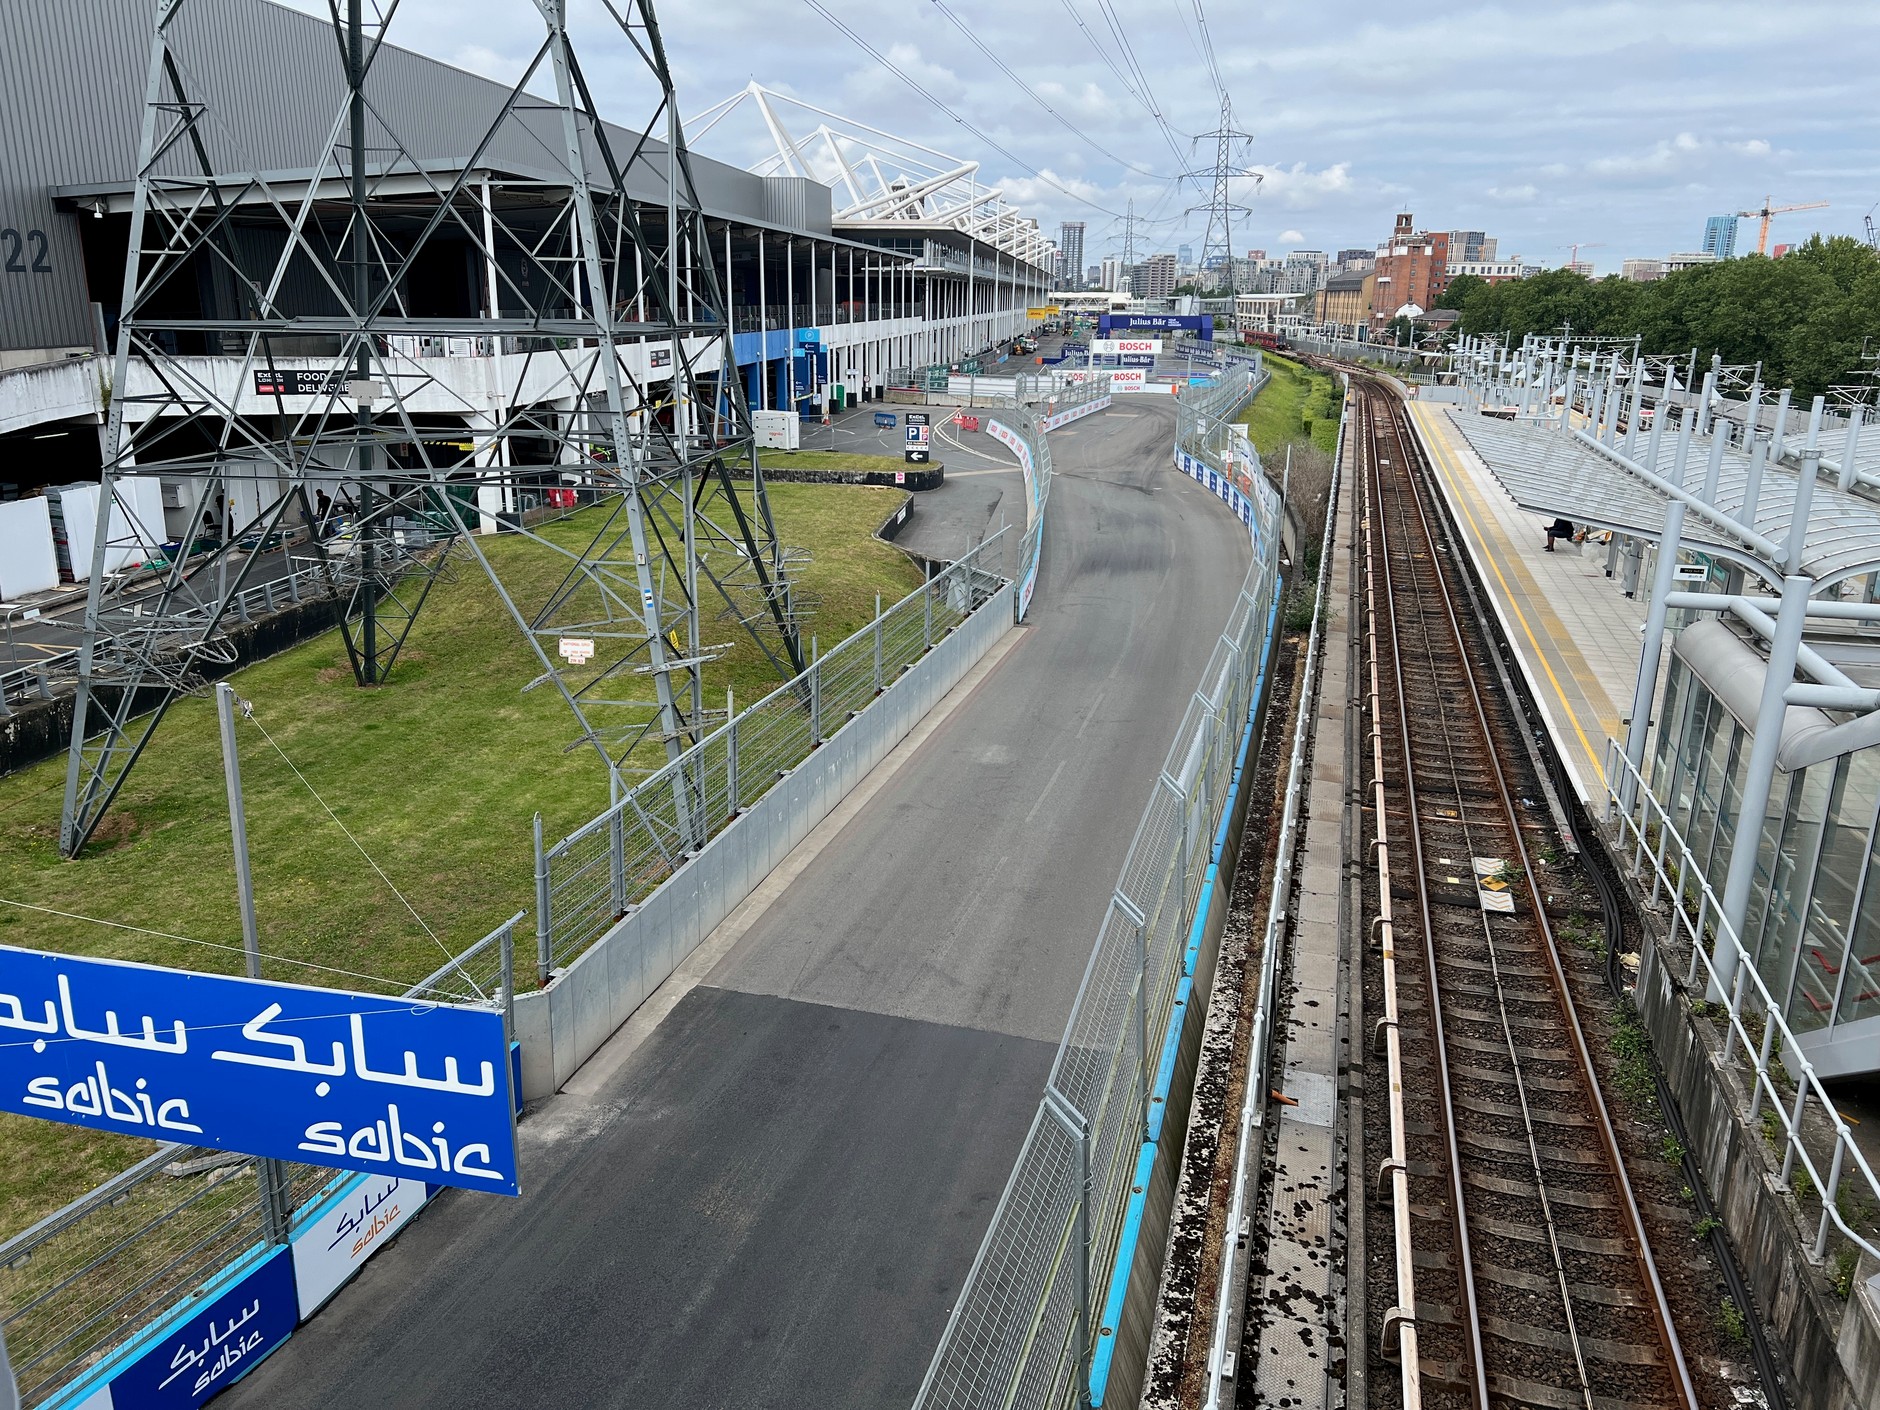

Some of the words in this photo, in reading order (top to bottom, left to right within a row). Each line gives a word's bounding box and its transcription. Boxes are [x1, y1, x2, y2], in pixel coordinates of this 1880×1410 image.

[1, 228, 52, 272] 22
[1129, 317, 1151, 327] Julius
[1152, 317, 1167, 326] Bär
[1119, 342, 1152, 350] BOSCH
[296, 372, 328, 381] FOOD
[908, 427, 918, 440] P
[23, 1061, 203, 1134] sabic
[298, 1104, 504, 1180] sabic
[351, 1204, 401, 1258] sabic
[192, 1330, 264, 1397] sabic
